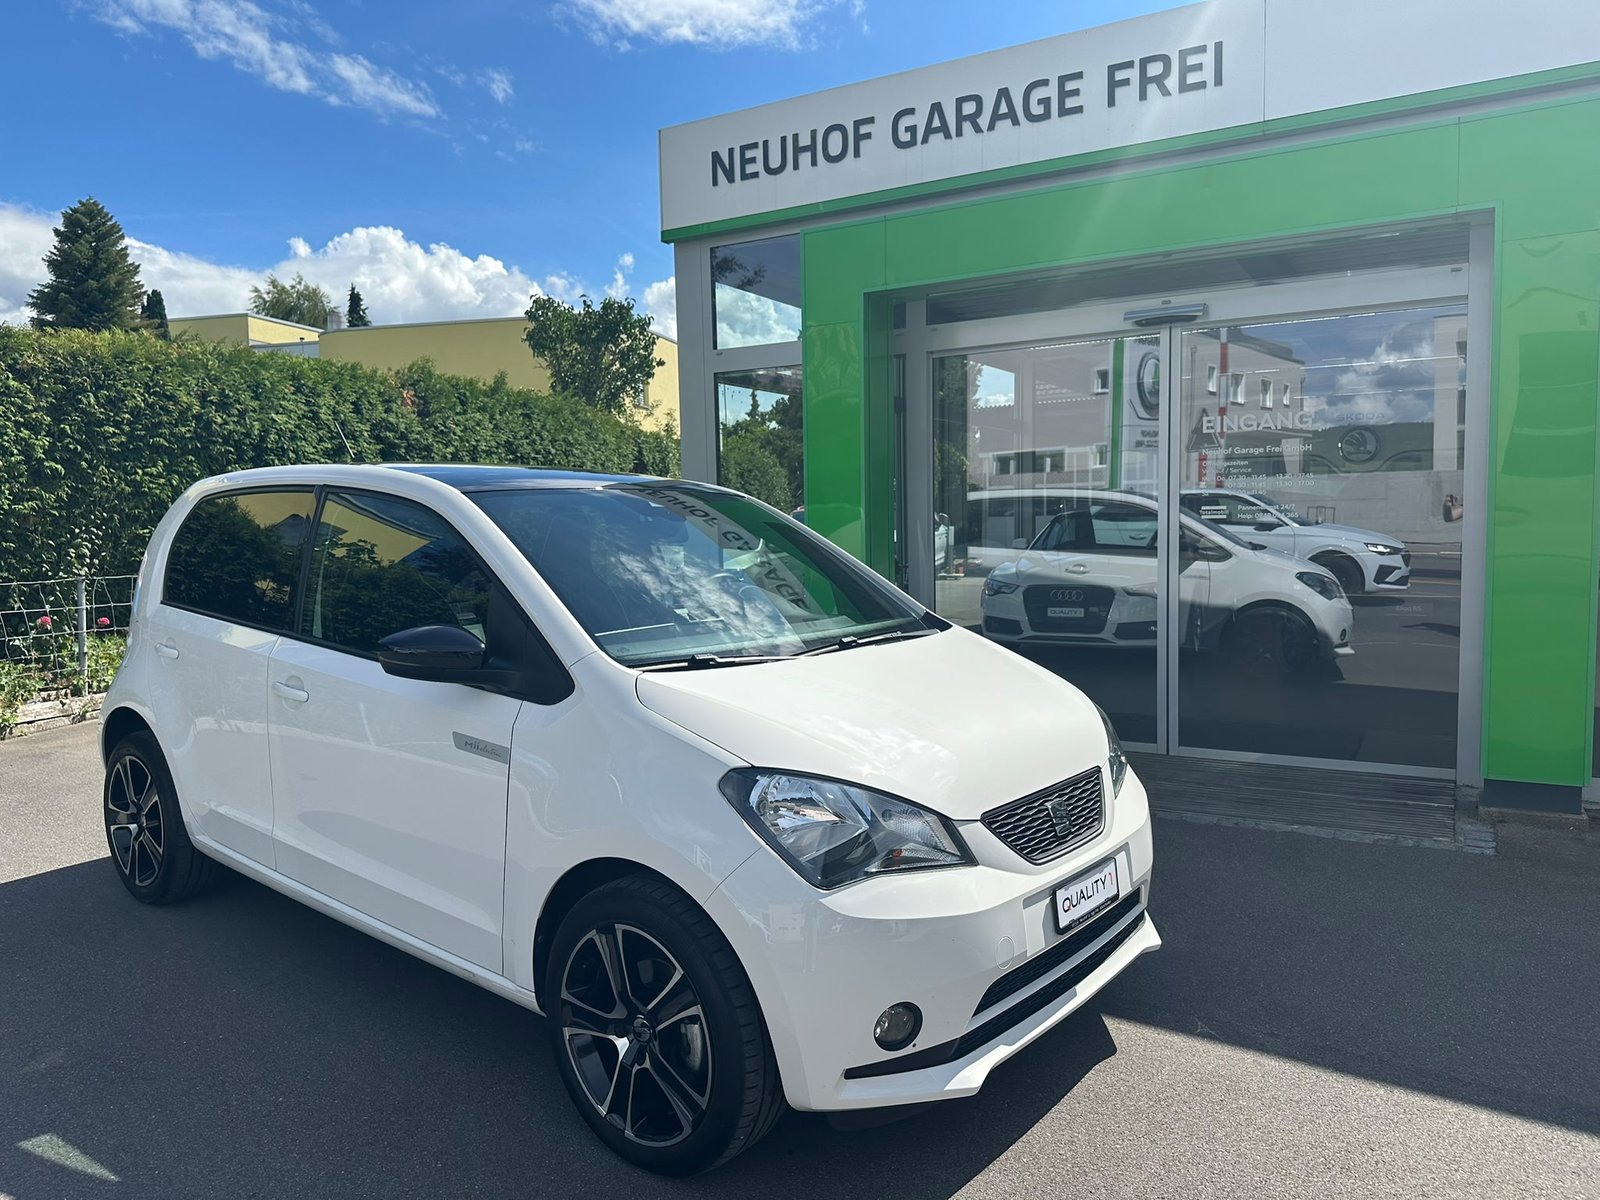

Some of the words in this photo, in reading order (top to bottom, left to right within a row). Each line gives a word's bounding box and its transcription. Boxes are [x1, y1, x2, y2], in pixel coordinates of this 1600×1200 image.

[711, 116, 876, 187] NEUHOF
[890, 70, 1085, 149] GARAGE
[1106, 40, 1225, 108] FREI
[1202, 411, 1312, 433] EINGANG
[1234, 445, 1264, 455] Garage
[1266, 444, 1282, 453] Frei
[1283, 443, 1312, 451] GmbH
[1237, 503, 1279, 511] Pannenst
[464, 740, 480, 751] Mii
[1062, 874, 1106, 913] QUALITY
